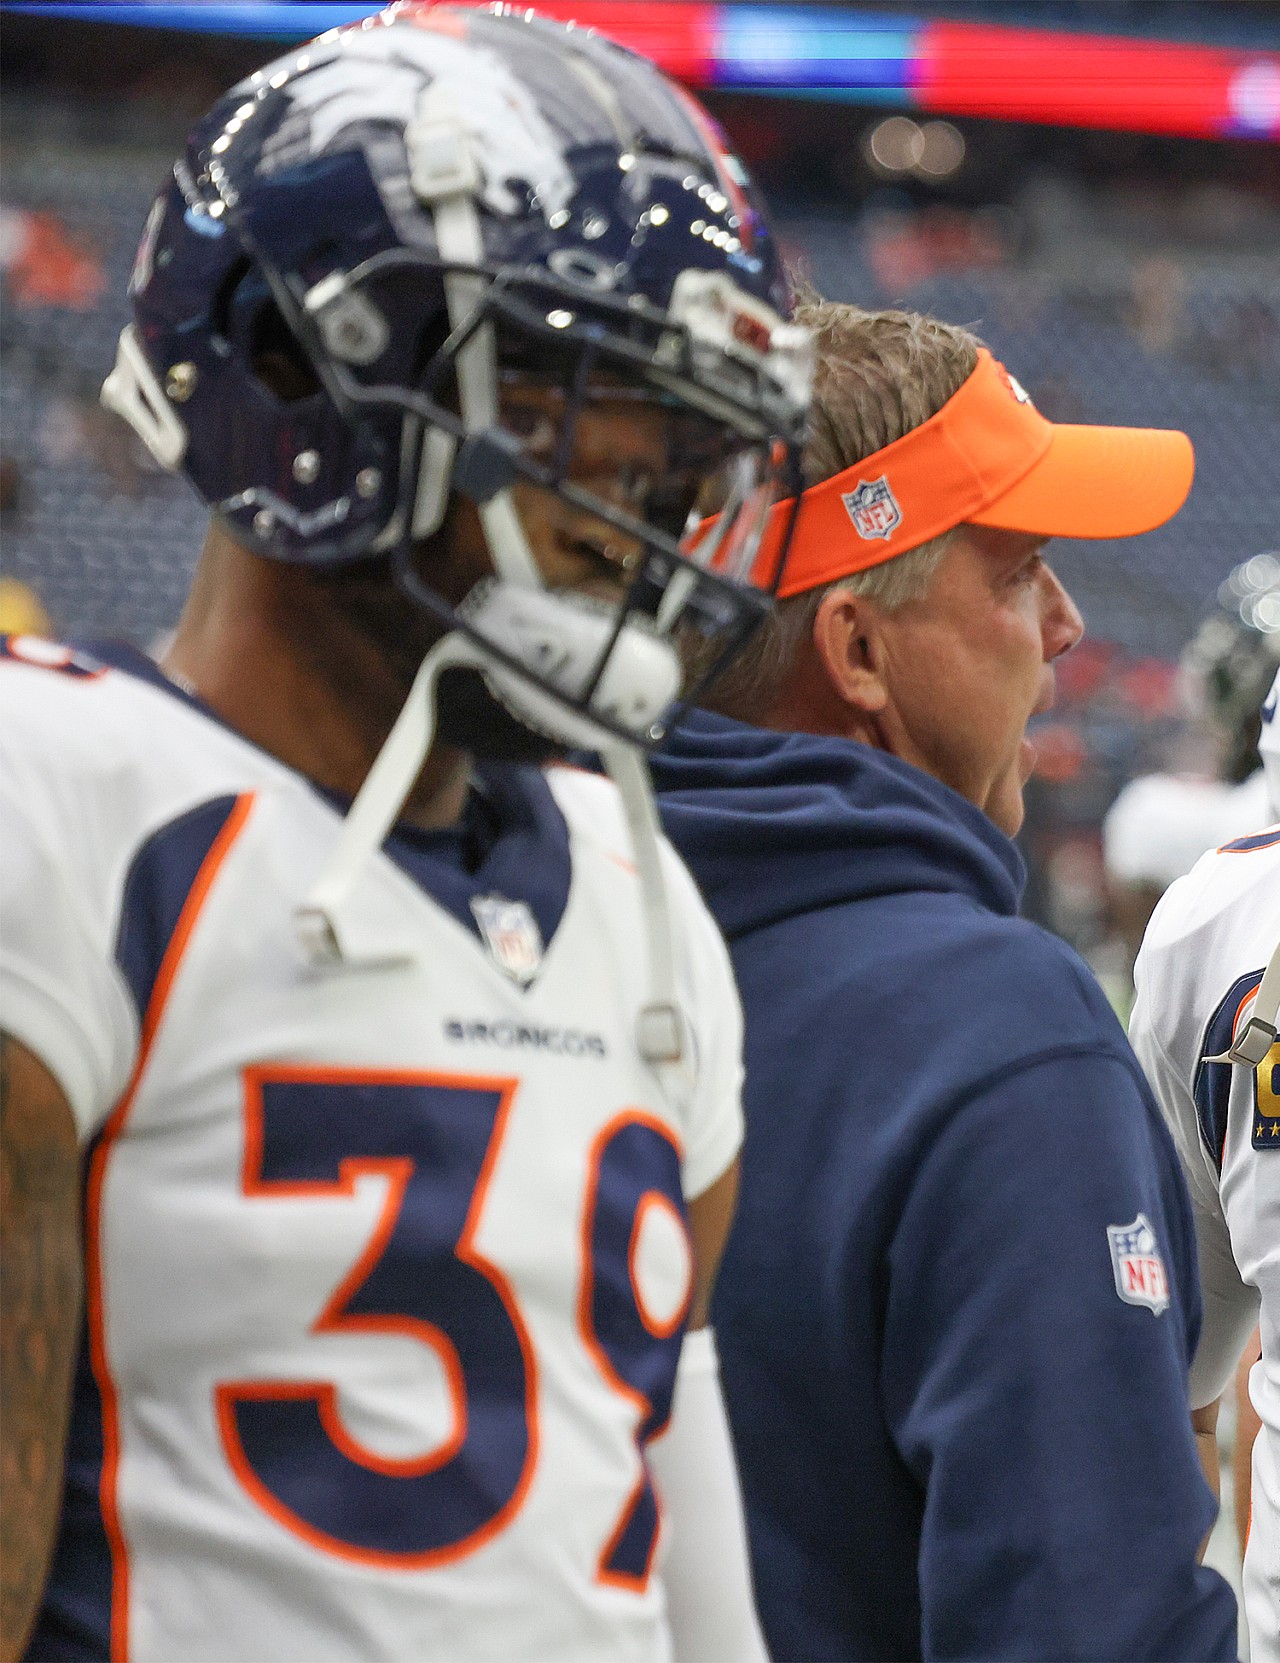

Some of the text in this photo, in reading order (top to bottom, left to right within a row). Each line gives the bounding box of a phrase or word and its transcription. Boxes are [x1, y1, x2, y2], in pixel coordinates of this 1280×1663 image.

[860, 501, 894, 533] NFL
[443, 1017, 607, 1060] BRONCOS
[214, 1062, 697, 1594] 39
